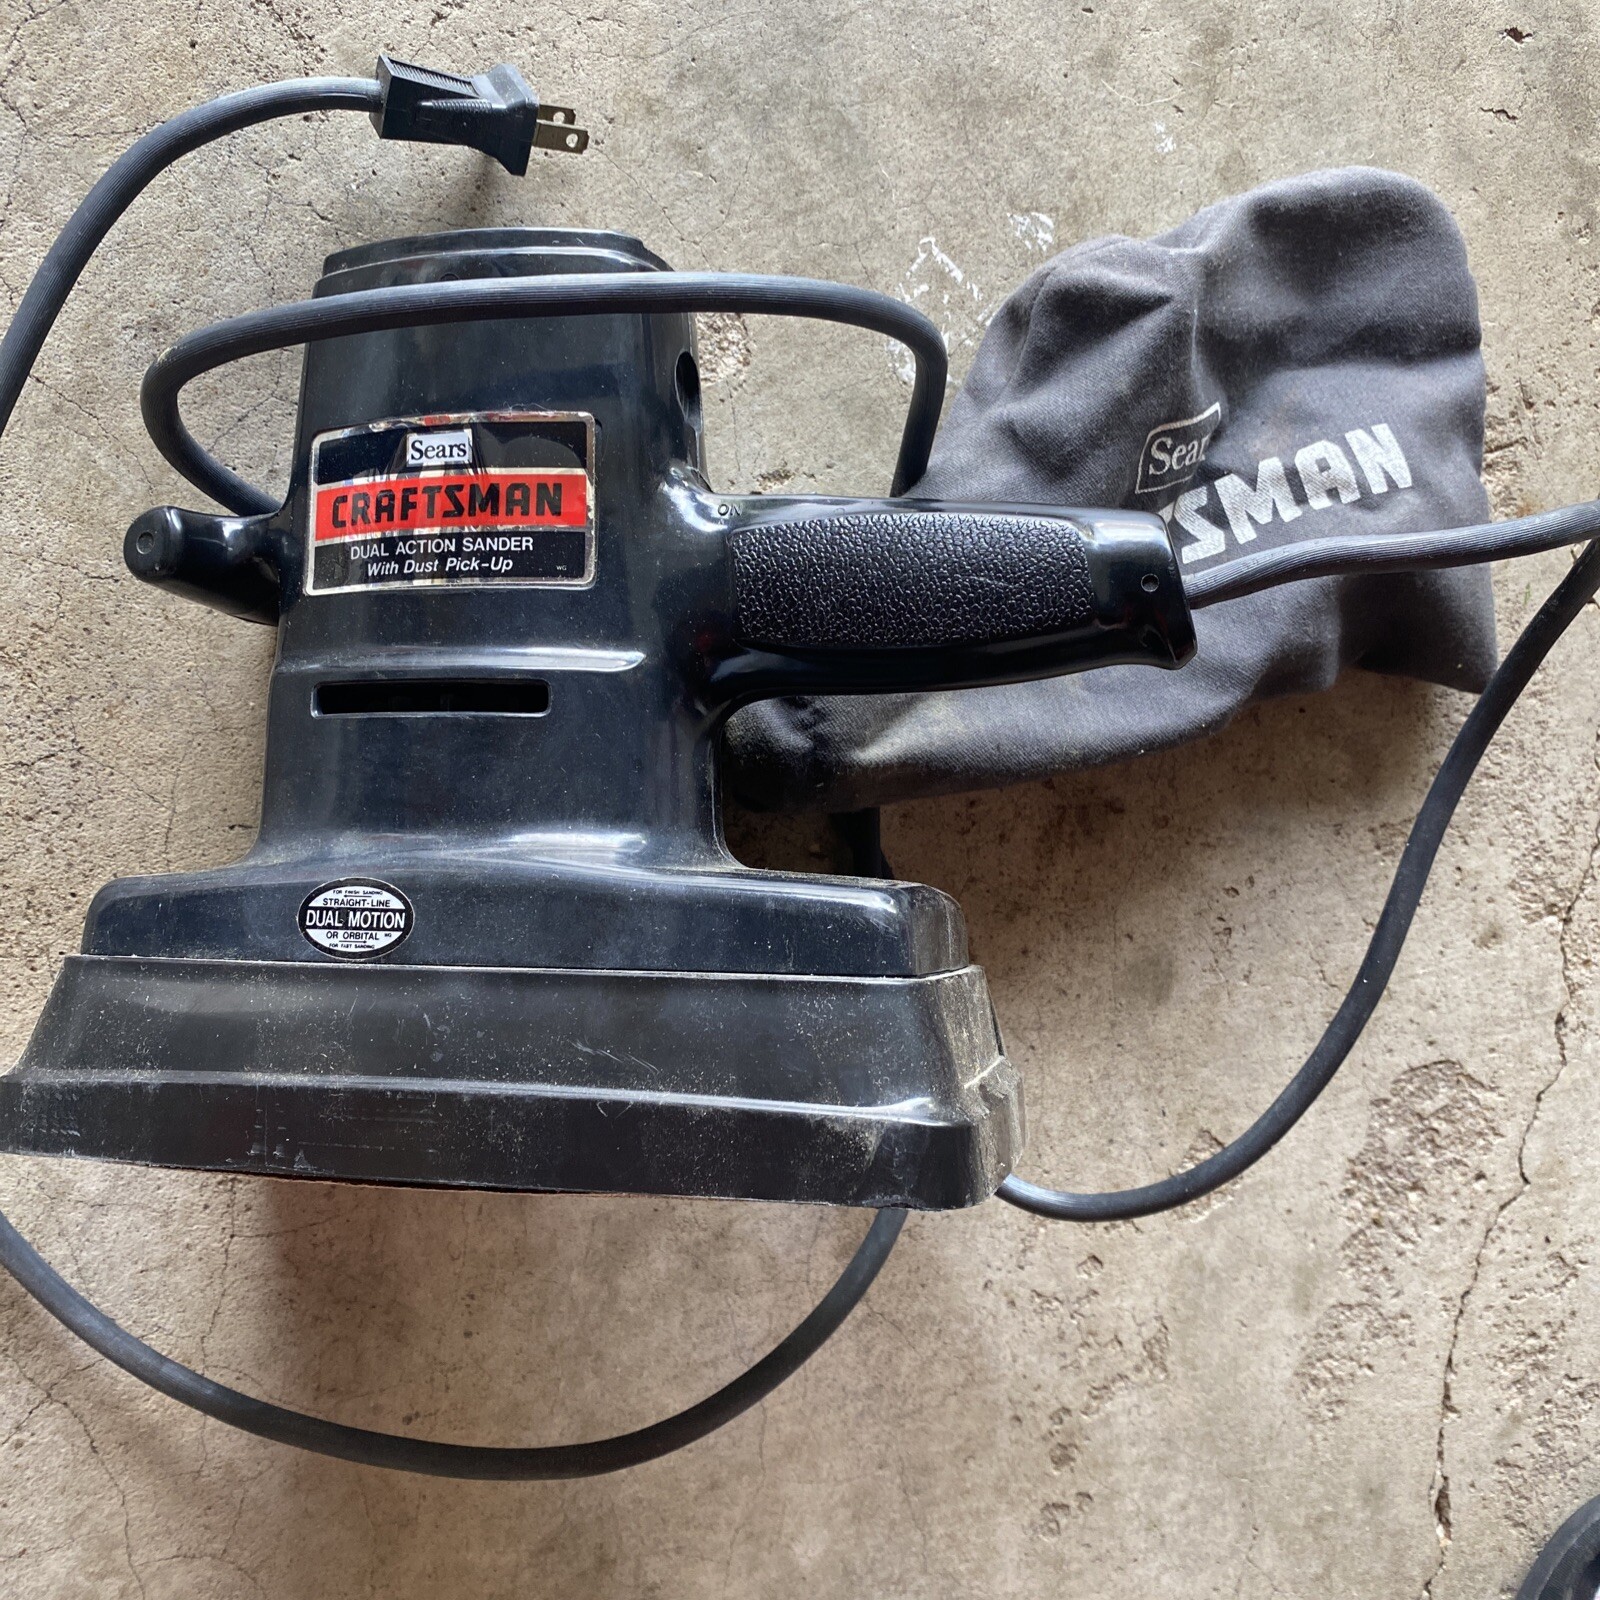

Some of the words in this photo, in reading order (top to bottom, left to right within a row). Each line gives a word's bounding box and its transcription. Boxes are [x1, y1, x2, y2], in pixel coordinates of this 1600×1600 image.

[410, 439, 468, 461] Sears
[1158, 422, 1413, 564] SMAN
[331, 481, 563, 529] CRAFTSMAN
[717, 503, 742, 516] ON
[350, 543, 389, 560] DUAL
[395, 537, 456, 556] ACTION
[462, 536, 534, 552] SANDER
[366, 560, 399, 576] With
[403, 557, 439, 574] Dust
[445, 555, 513, 574] Pick-Up
[322, 897, 391, 908] STRAIGHT-LINE
[305, 909, 343, 927] DUAL
[347, 910, 406, 929] MOTION
[325, 930, 339, 940] OR
[342, 931, 380, 941] ORBITAL
